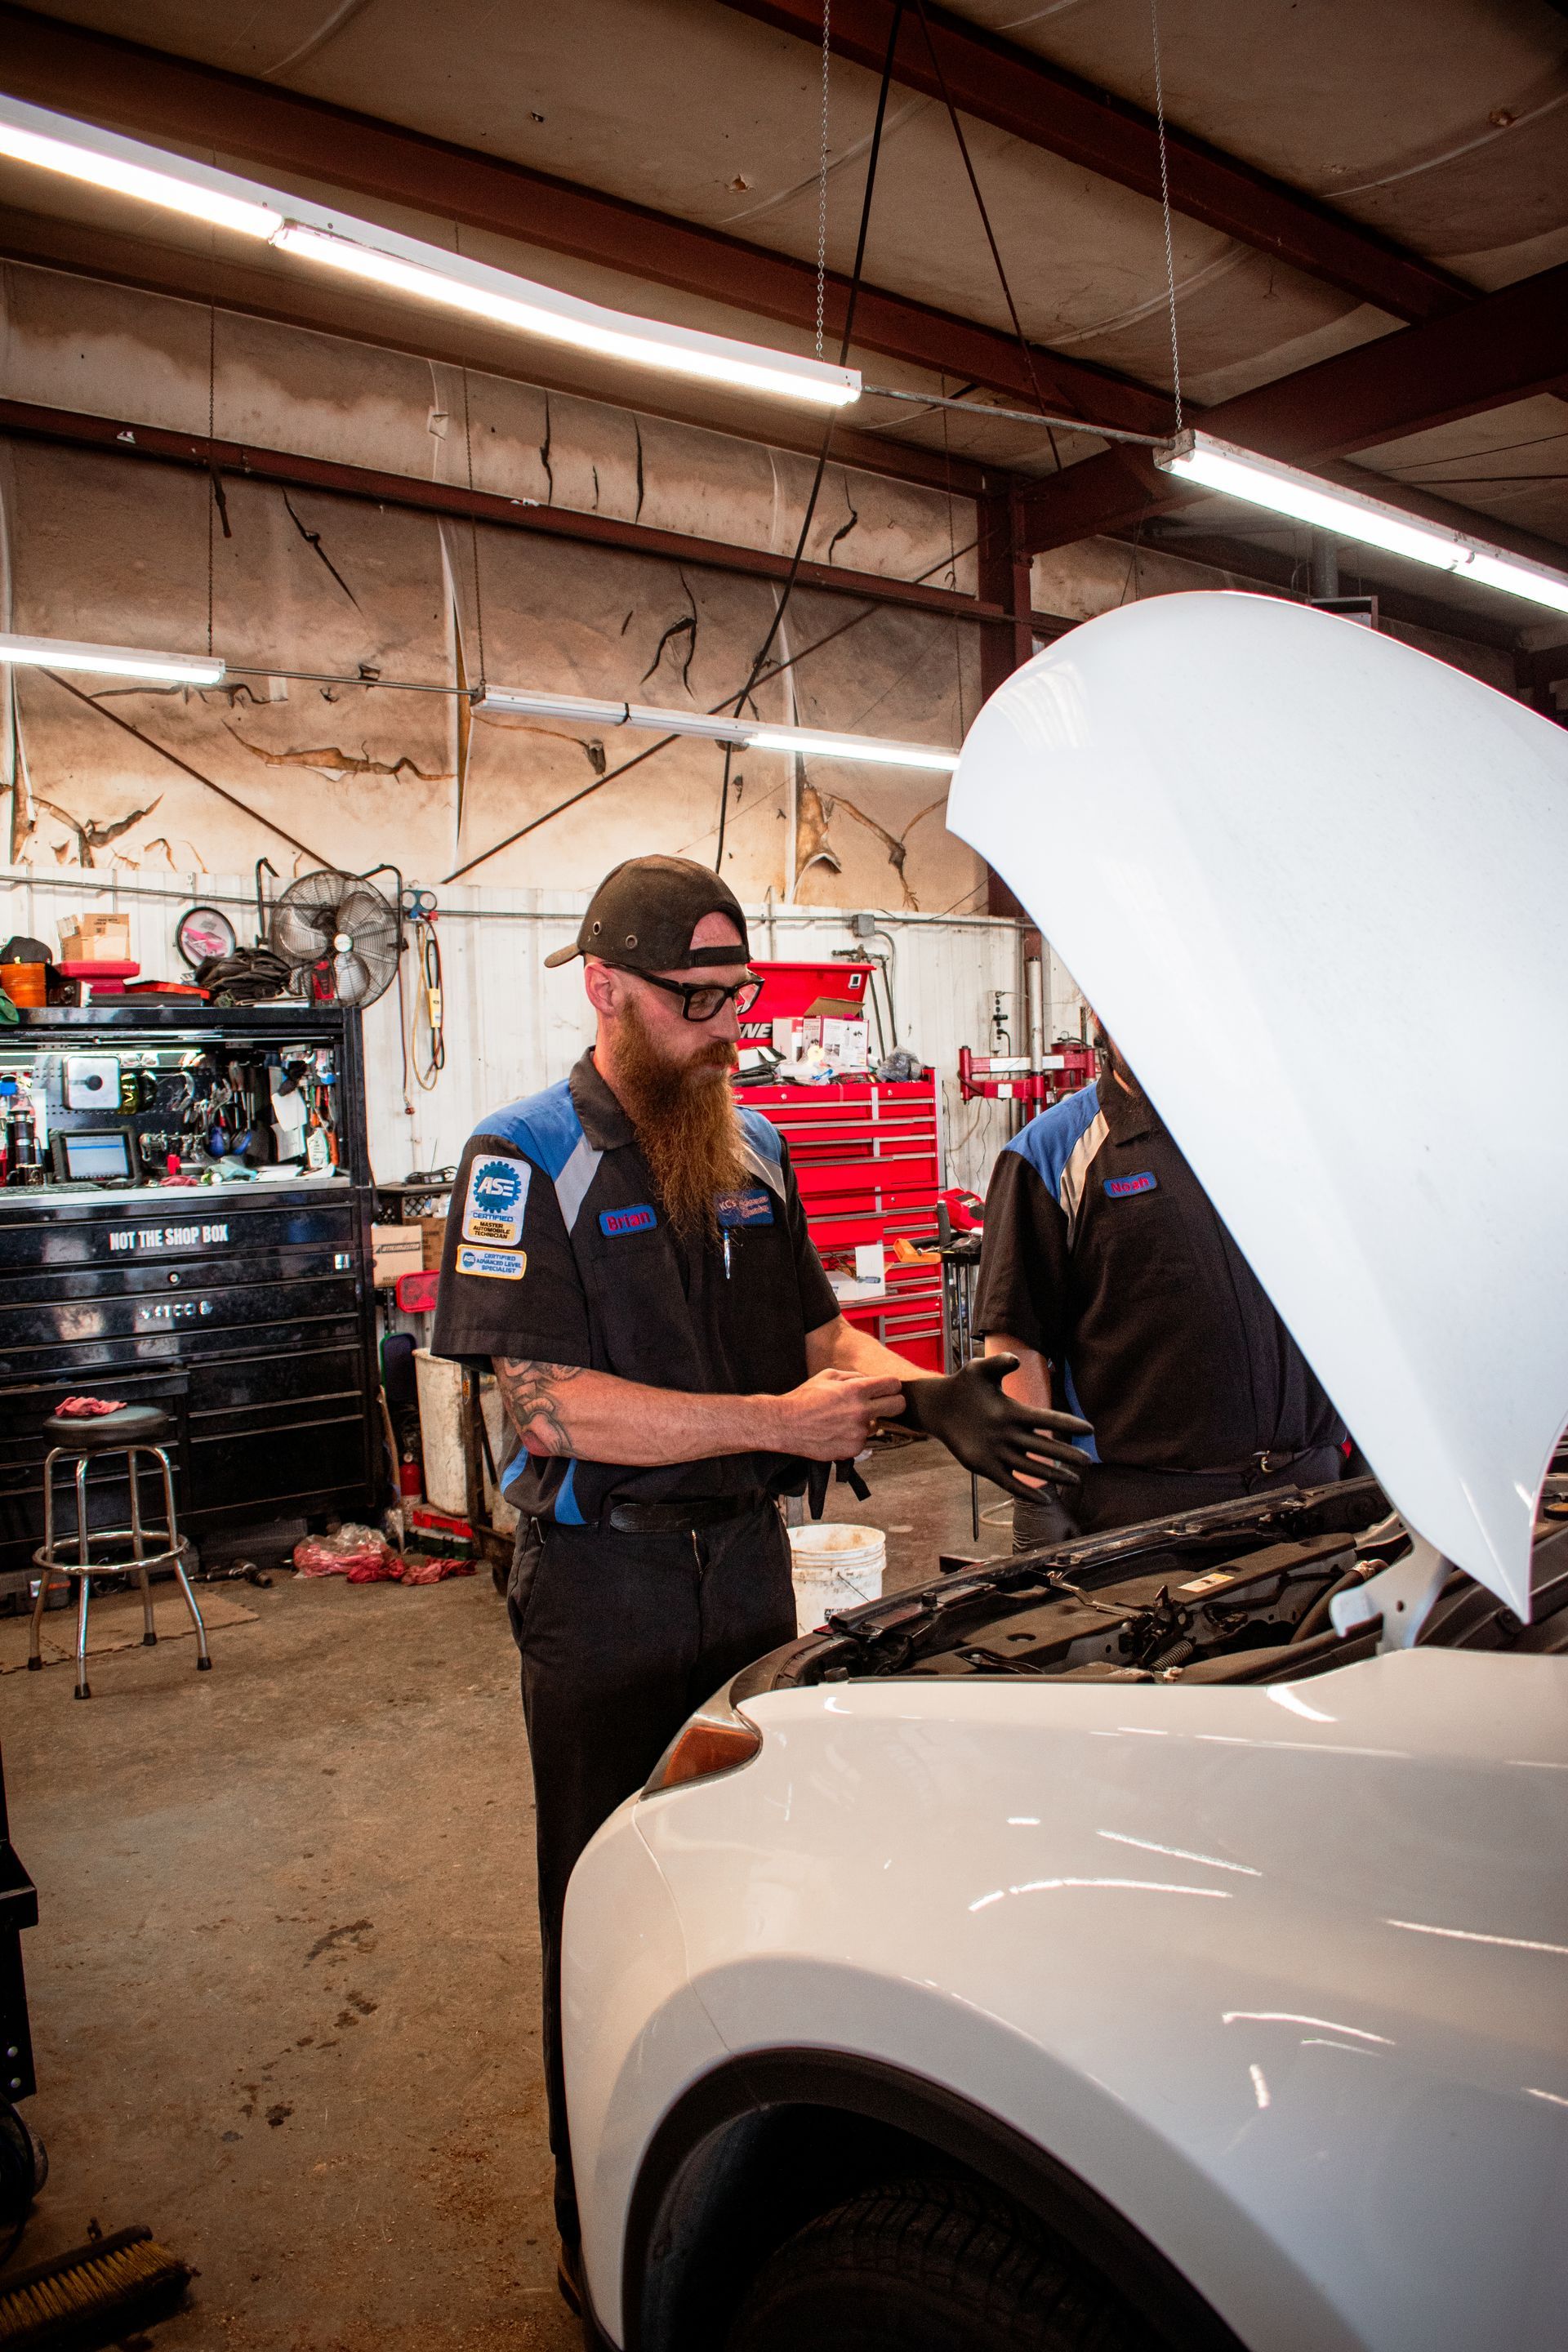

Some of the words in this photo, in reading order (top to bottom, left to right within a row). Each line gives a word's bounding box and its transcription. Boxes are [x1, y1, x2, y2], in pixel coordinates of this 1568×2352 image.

[738, 1022, 772, 1039] NE
[477, 1176, 515, 1197] ASE
[1111, 1177, 1149, 1192] Noah
[472, 1212, 514, 1223] CERTIFIED
[605, 1210, 651, 1232] Brian
[473, 1225, 511, 1235] AUTOMOBILE
[474, 1231, 508, 1240] TECHNICIAN
[109, 1231, 136, 1250] NOT
[138, 1229, 163, 1248] THE
[165, 1226, 200, 1246] SHOP
[202, 1224, 229, 1243] BOX
[476, 1258, 504, 1266] ADVANCED
[483, 1253, 516, 1261] CERTIFIED
[481, 1264, 516, 1273] SPECIALIST
